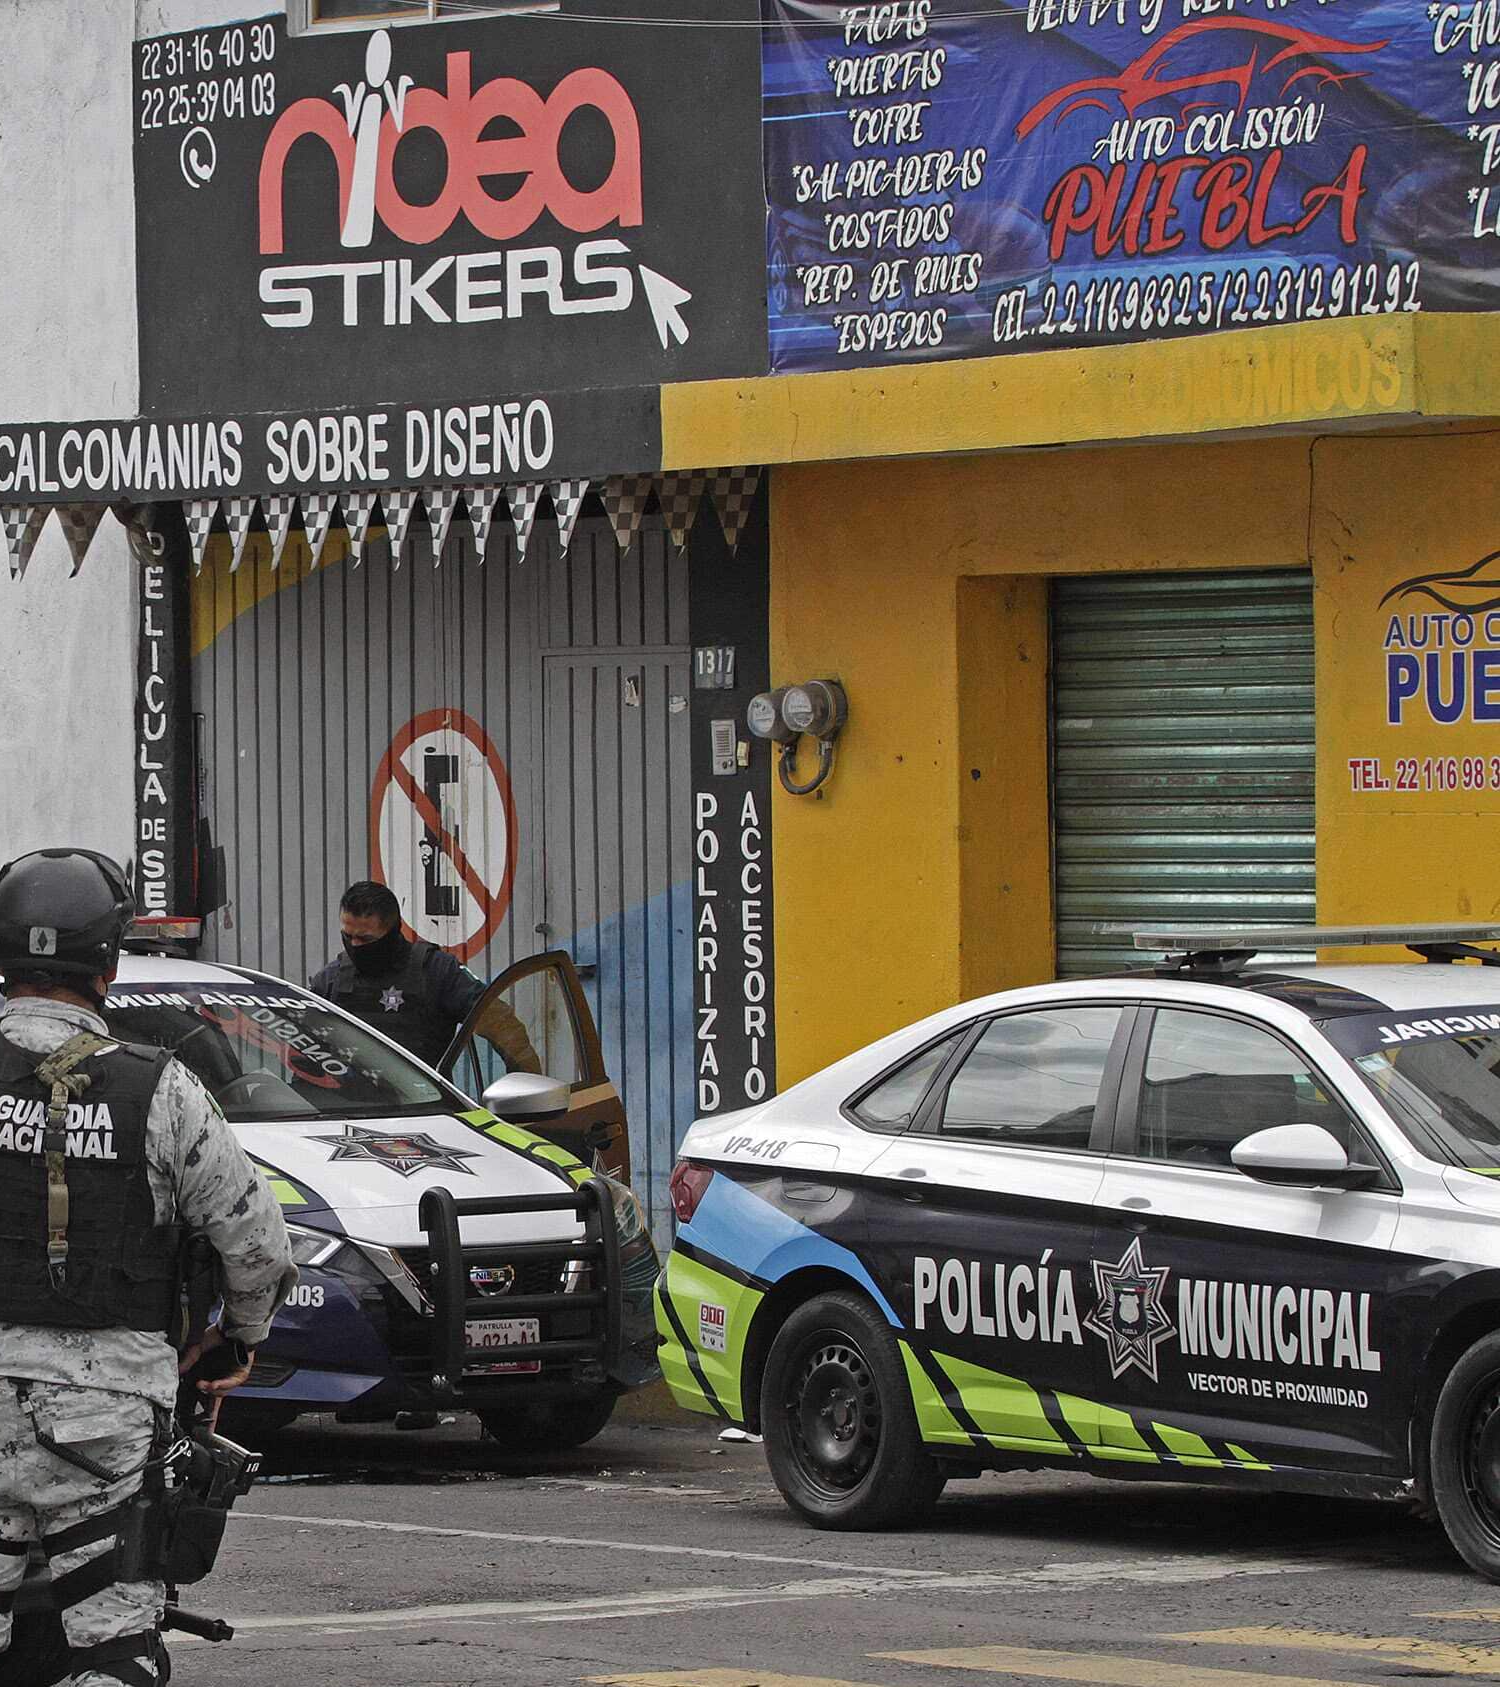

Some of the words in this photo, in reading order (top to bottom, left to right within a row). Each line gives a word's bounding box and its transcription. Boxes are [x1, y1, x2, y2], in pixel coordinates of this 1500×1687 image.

[141, 43, 161, 80] 22
[218, 28, 245, 68] 40
[249, 23, 275, 62] 30
[141, 87, 164, 128] 22
[251, 72, 275, 115] 03
[1092, 117, 1174, 164] AUTO
[1185, 96, 1325, 156] COLISIÓN
[1043, 144, 1368, 262] PUEBLA
[259, 239, 632, 328] STIKERS
[869, 259, 909, 302] DE
[914, 253, 983, 297] RINES
[266, 413, 389, 483] SOBRE
[405, 399, 553, 478] DISEÑO
[1384, 613, 1474, 649] AUTO
[698, 649, 734, 675] 1317
[1348, 758, 1390, 792] TEL.
[1395, 758, 1420, 791] 22
[1462, 756, 1485, 790] 98
[141, 818, 167, 843] DE
[724, 1136, 787, 1159] VP-418
[702, 1306, 723, 1325] 911
[914, 1249, 1083, 1345] POLICÍA
[1178, 1278, 1381, 1371] MUNICIPAL
[1188, 1372, 1249, 1396] VECTOR
[1250, 1378, 1273, 1398] DE
[1275, 1381, 1368, 1408] PROXIMIDAD
